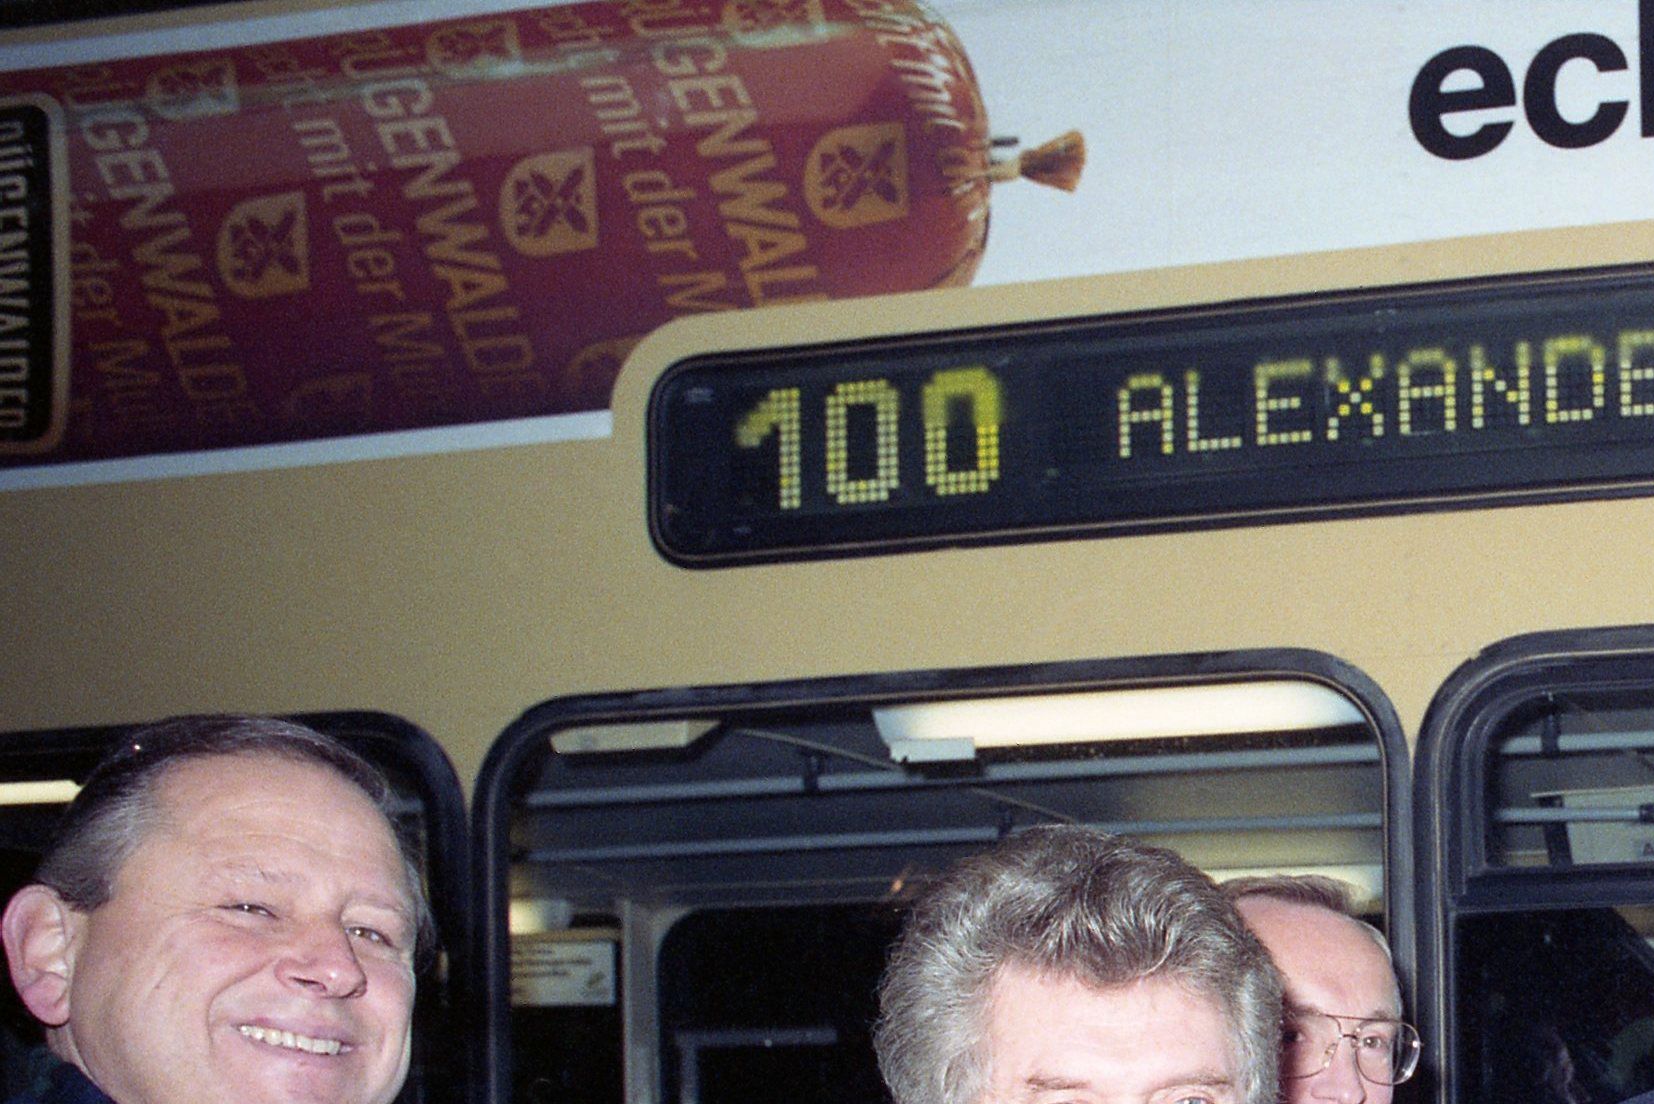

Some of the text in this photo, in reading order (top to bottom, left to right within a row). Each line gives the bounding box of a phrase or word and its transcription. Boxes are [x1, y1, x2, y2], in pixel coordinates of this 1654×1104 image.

[293, 115, 378, 202] mit
[580, 76, 670, 160] mit
[332, 211, 407, 301] der
[623, 163, 700, 262] der
[736, 366, 1000, 512] 100
